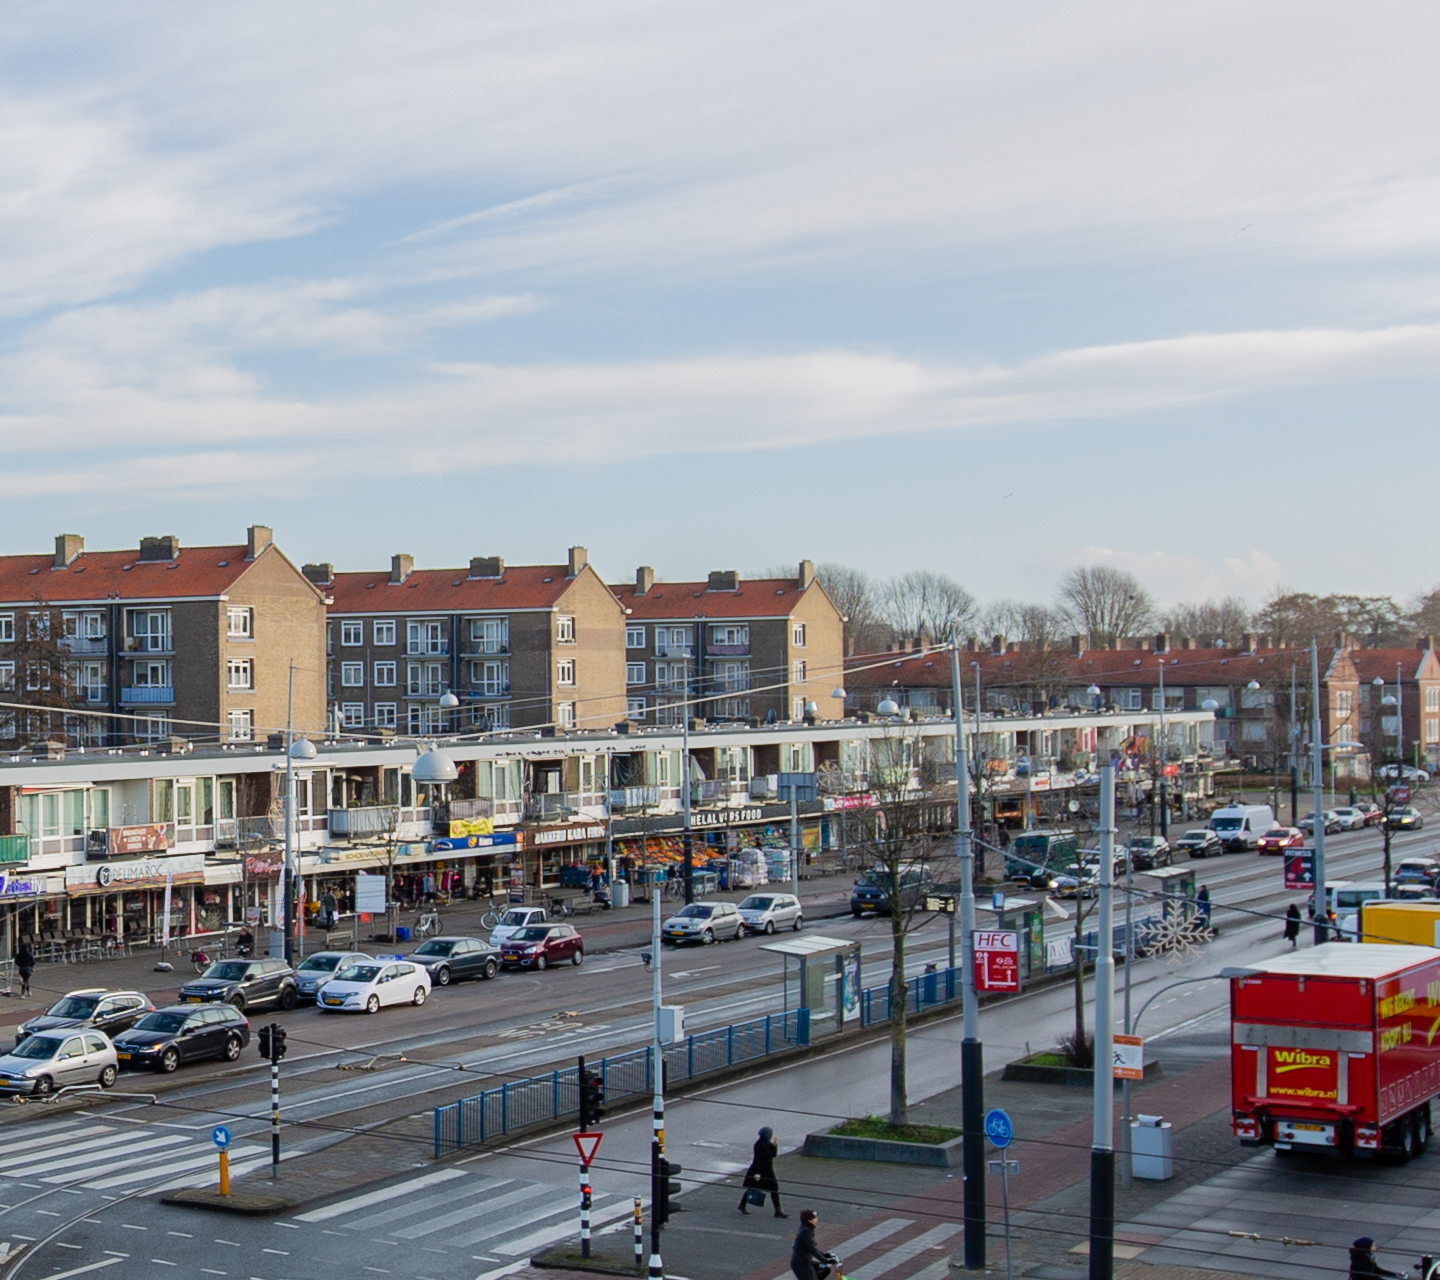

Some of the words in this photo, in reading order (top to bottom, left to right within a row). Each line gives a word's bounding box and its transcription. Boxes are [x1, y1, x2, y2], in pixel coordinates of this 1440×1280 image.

[741, 808, 762, 821] FOOD
[978, 933, 1012, 947] HFC
[1275, 1049, 1330, 1066] Wibra
[1269, 1086, 1337, 1099] www.wibra.nl
